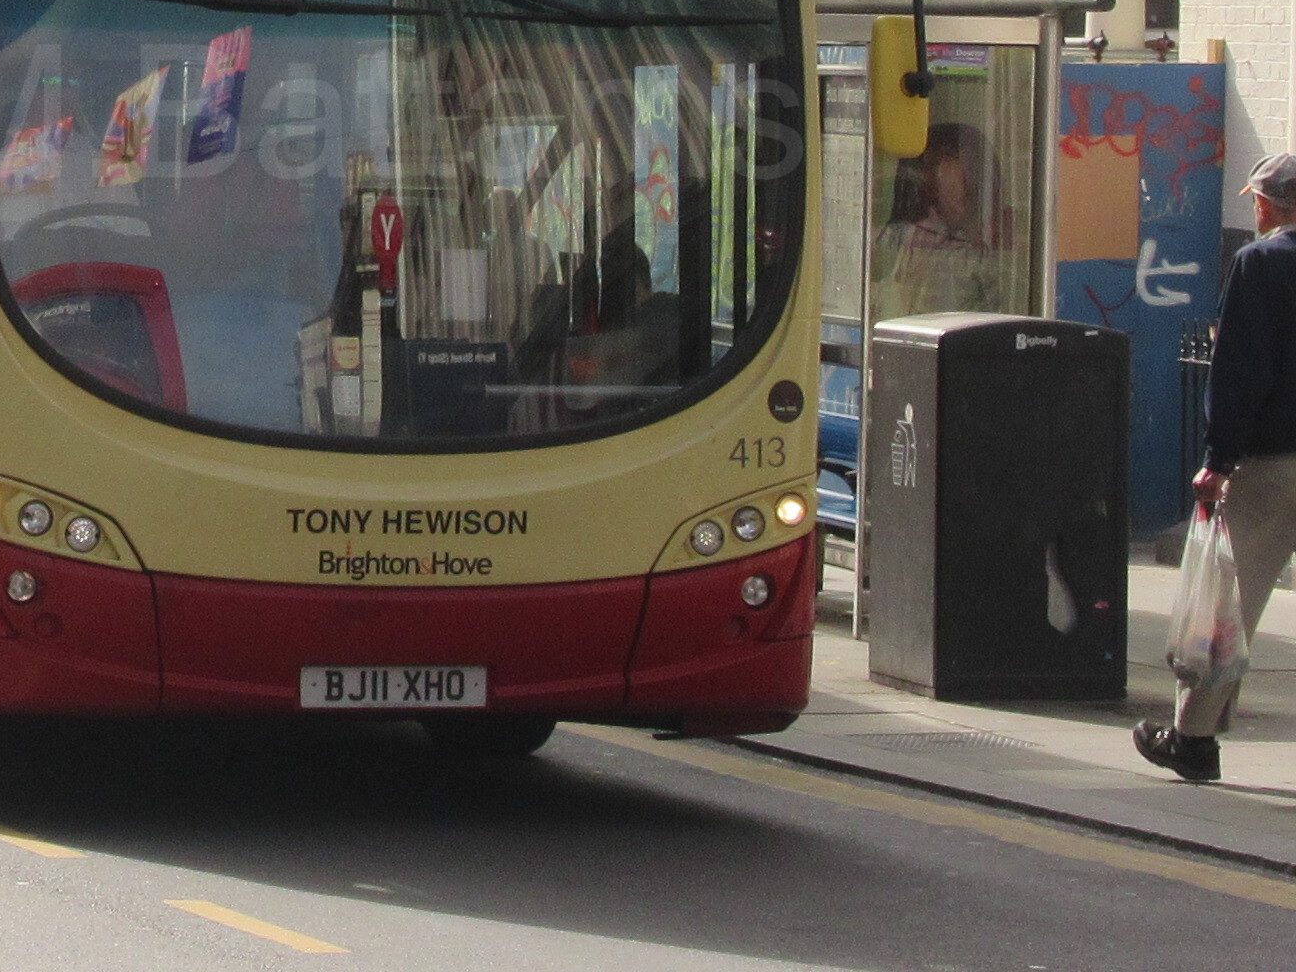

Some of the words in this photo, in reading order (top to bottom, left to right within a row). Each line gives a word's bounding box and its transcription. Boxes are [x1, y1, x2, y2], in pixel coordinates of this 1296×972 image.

[380, 214, 397, 250] Y
[1015, 332, 1058, 350] Bigbelly
[728, 436, 786, 469] 413
[286, 508, 372, 534] TONY
[381, 509, 528, 535] HEWISON
[324, 669, 389, 702] BJ11
[402, 669, 465, 702] XHO
